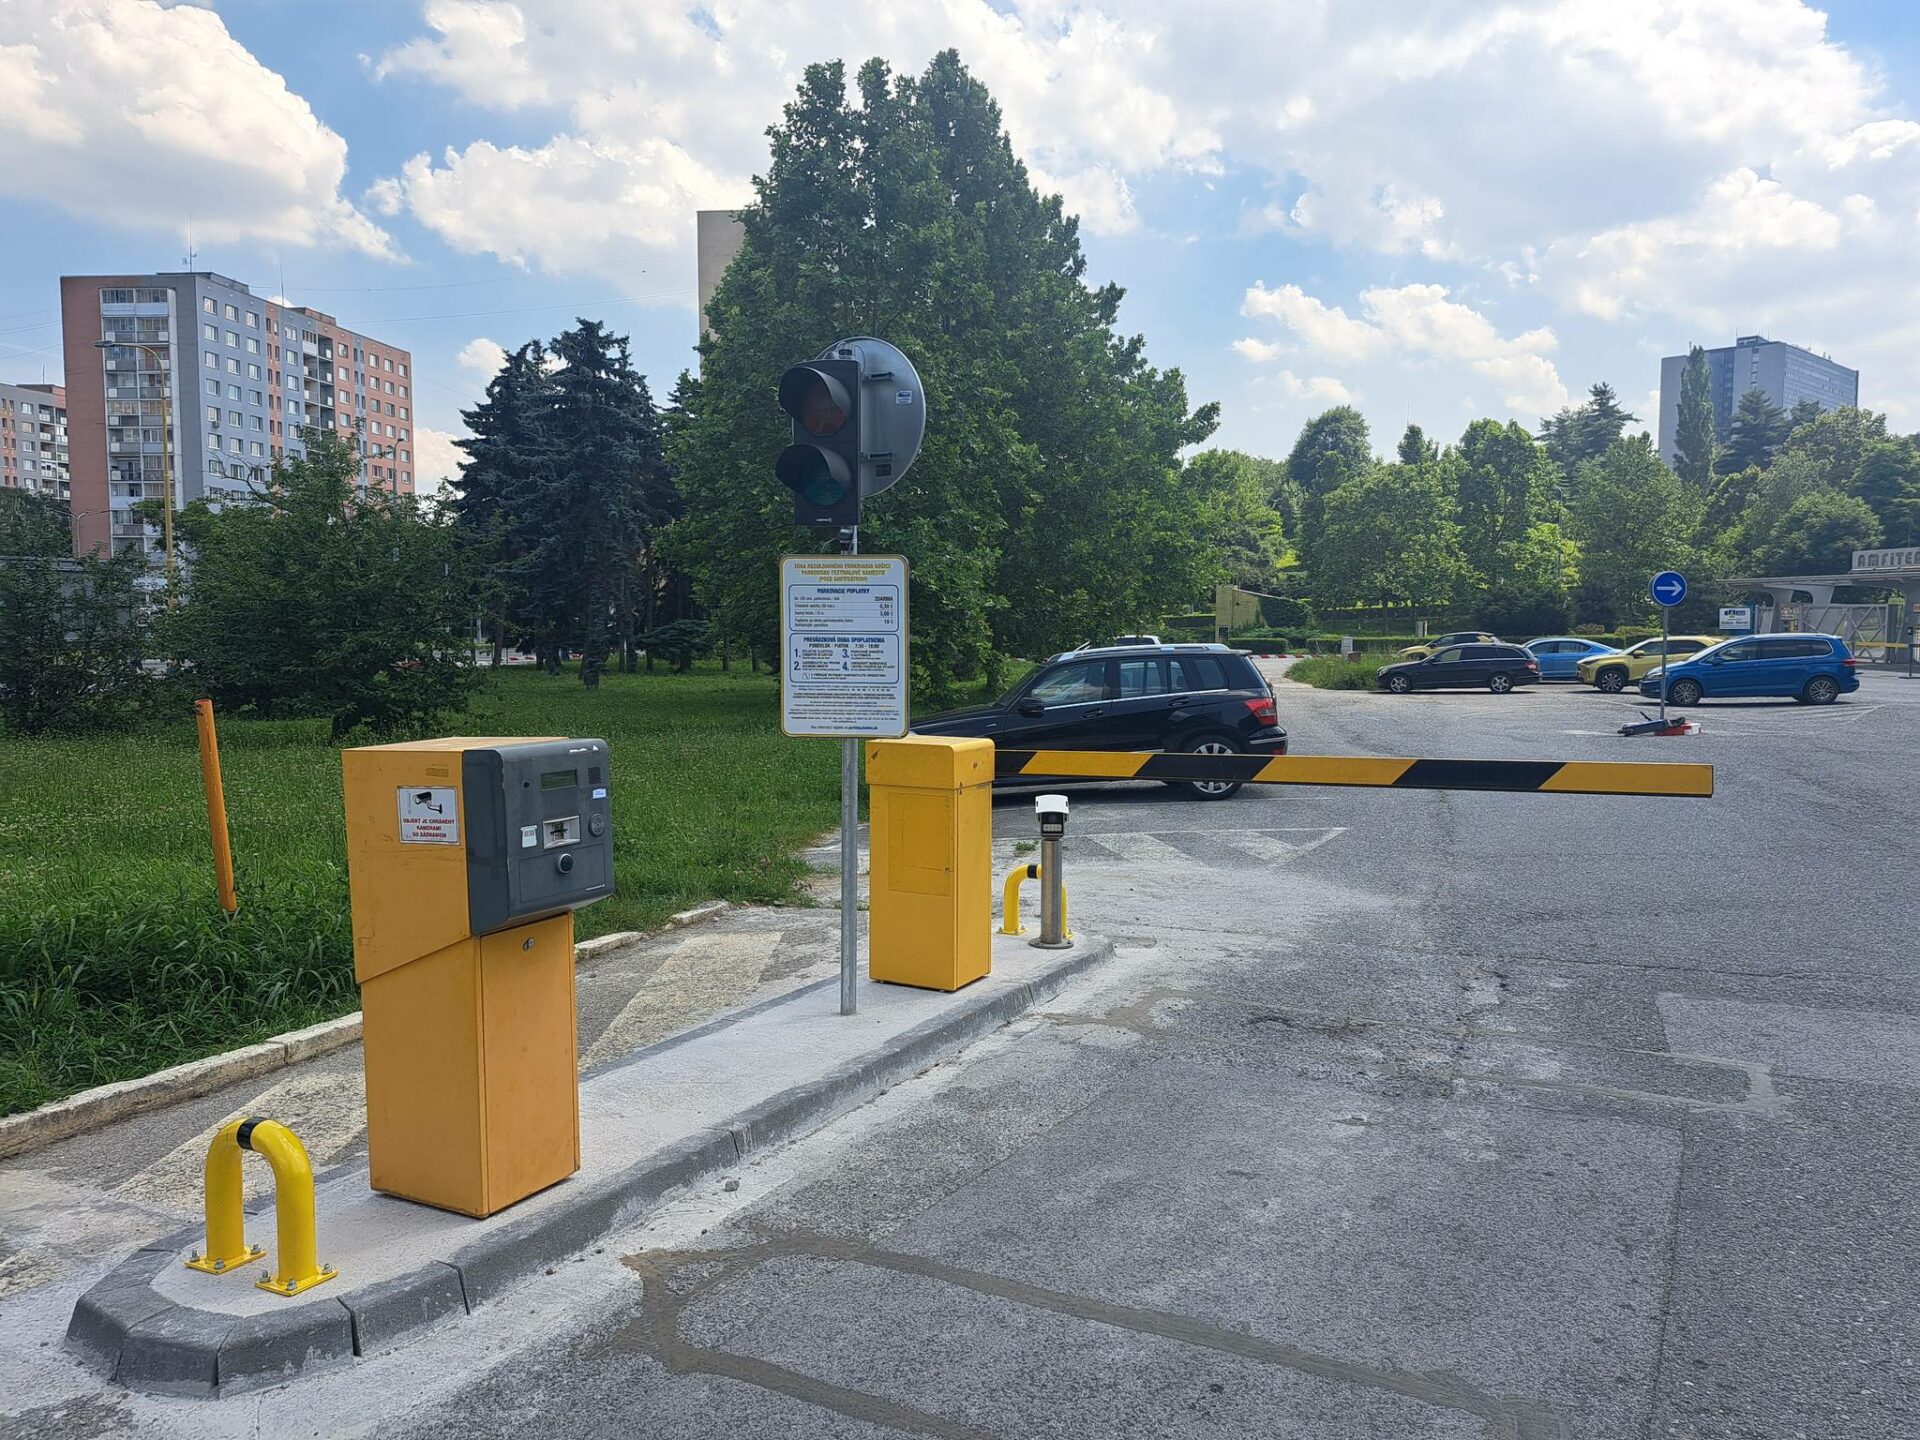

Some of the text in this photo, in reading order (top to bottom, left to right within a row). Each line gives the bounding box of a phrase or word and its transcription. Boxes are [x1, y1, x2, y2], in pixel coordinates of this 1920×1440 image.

[794, 649, 801, 658] 1.
[842, 649, 849, 658] 3.
[794, 661, 801, 671] 2.
[842, 661, 849, 671] 4.
